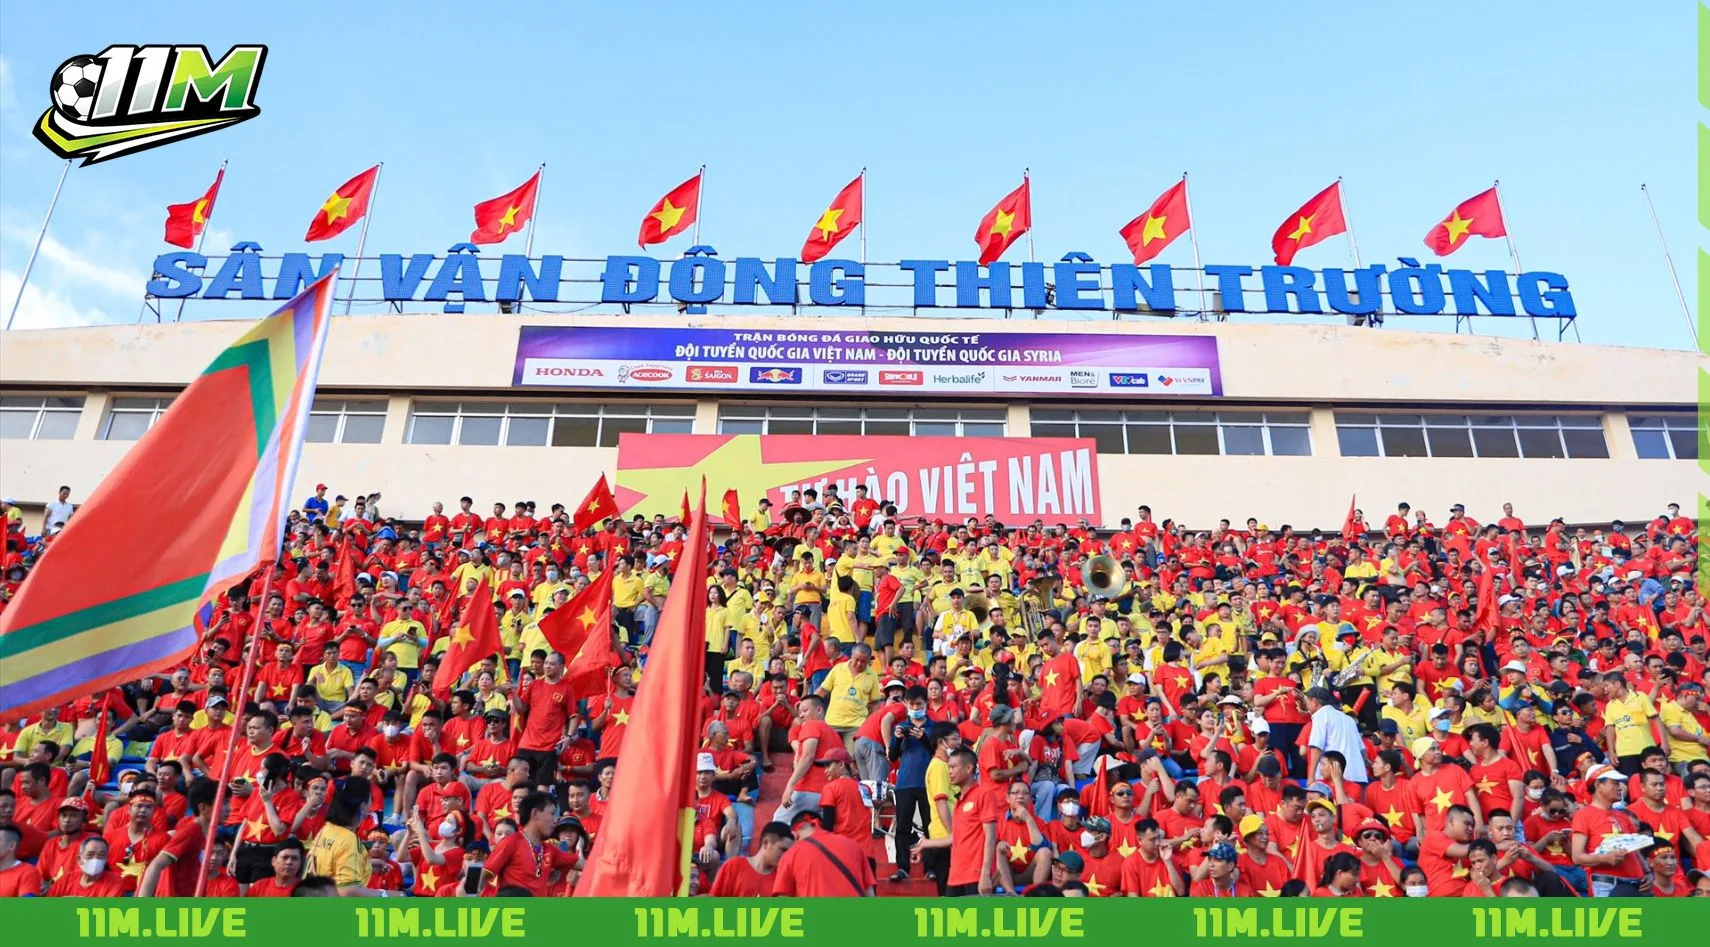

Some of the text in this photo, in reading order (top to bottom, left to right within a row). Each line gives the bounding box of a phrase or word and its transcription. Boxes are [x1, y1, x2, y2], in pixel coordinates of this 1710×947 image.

[146, 241, 1577, 318] SÂN VẬN ĐỘNG THIÊN TRƯỜNG
[734, 332, 980, 345] TRẬN BÓNG ĐÁ GIAO HỮU QUỐC TẾ
[675, 343, 699, 361] ĐỘI
[703, 342, 746, 359] TUYỂN
[748, 343, 784, 360] QUỐC
[787, 347, 810, 360] GIA
[813, 345, 842, 363] VIỆT
[845, 349, 876, 361] NAM
[886, 346, 910, 364] ĐỘI
[913, 345, 956, 361] TUYỂN
[959, 346, 996, 363] QUỐC
[998, 350, 1021, 362] GIA
[1024, 350, 1062, 362] SYRIA
[535, 367, 604, 377] HONDA
[934, 374, 981, 384] Herbalife
[919, 452, 997, 525] VIỆT
[1008, 448, 1095, 514] NAM
